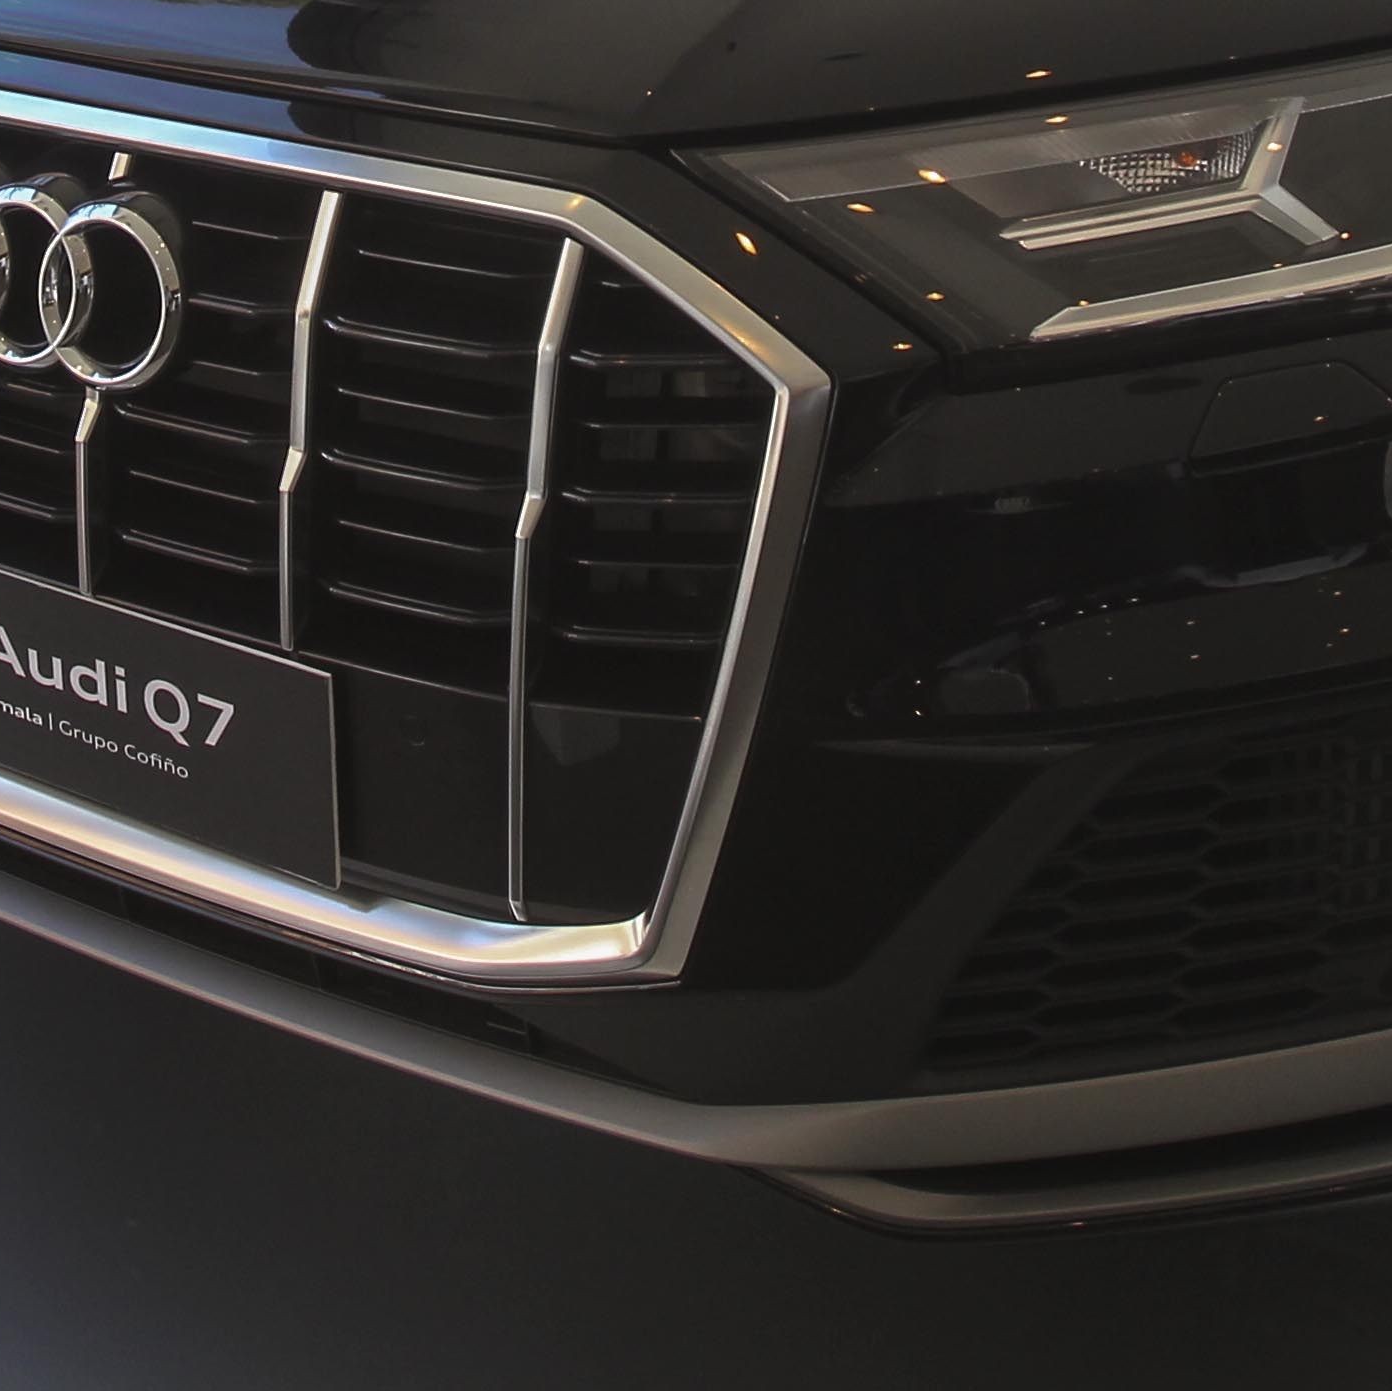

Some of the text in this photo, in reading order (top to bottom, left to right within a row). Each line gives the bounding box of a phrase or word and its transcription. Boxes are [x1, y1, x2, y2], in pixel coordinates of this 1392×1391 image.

[143, 679, 235, 747] Q7
[59, 719, 118, 753] Grupo
[124, 744, 189, 778] Cofiño
